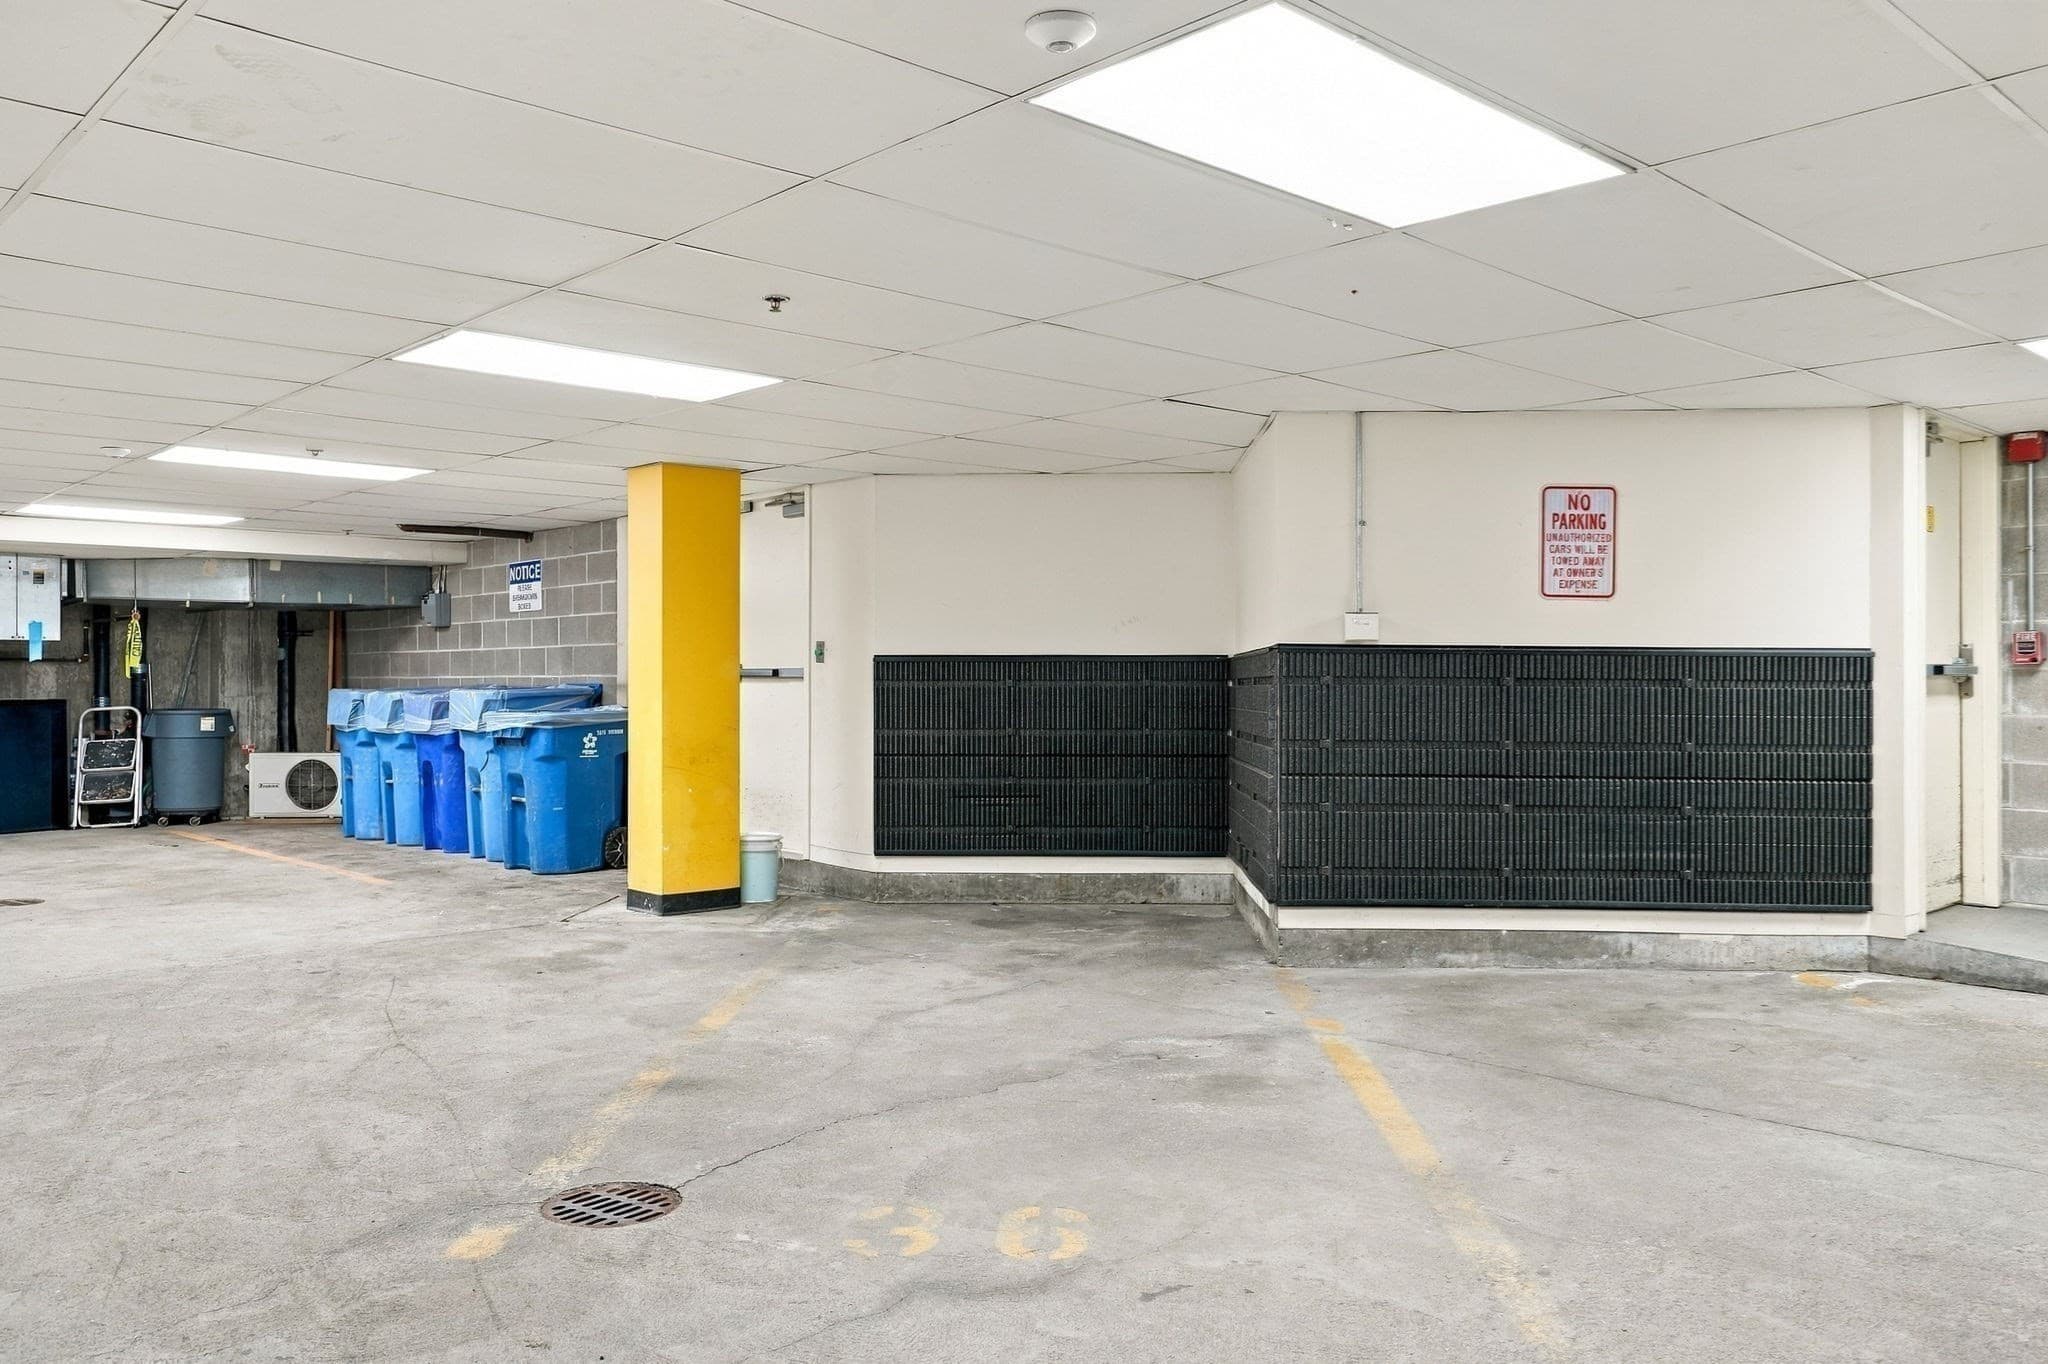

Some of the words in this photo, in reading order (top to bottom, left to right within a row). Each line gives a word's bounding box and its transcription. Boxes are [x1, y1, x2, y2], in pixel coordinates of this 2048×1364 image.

[1567, 494, 1591, 511] NO
[1551, 513, 1607, 530] PARKING
[1546, 533, 1612, 543] UNAUTHORIZED
[1548, 545, 1572, 554] CARS
[1574, 545, 1595, 554] WILL
[1597, 545, 1609, 554] BE
[1551, 556, 1579, 566] TOWED
[1582, 557, 1606, 566] AWAY
[510, 563, 541, 581] NOTICE
[1552, 568, 1564, 577] AT
[1558, 580, 1599, 589] EXPENSE
[842, 1205, 1090, 1262] 36
